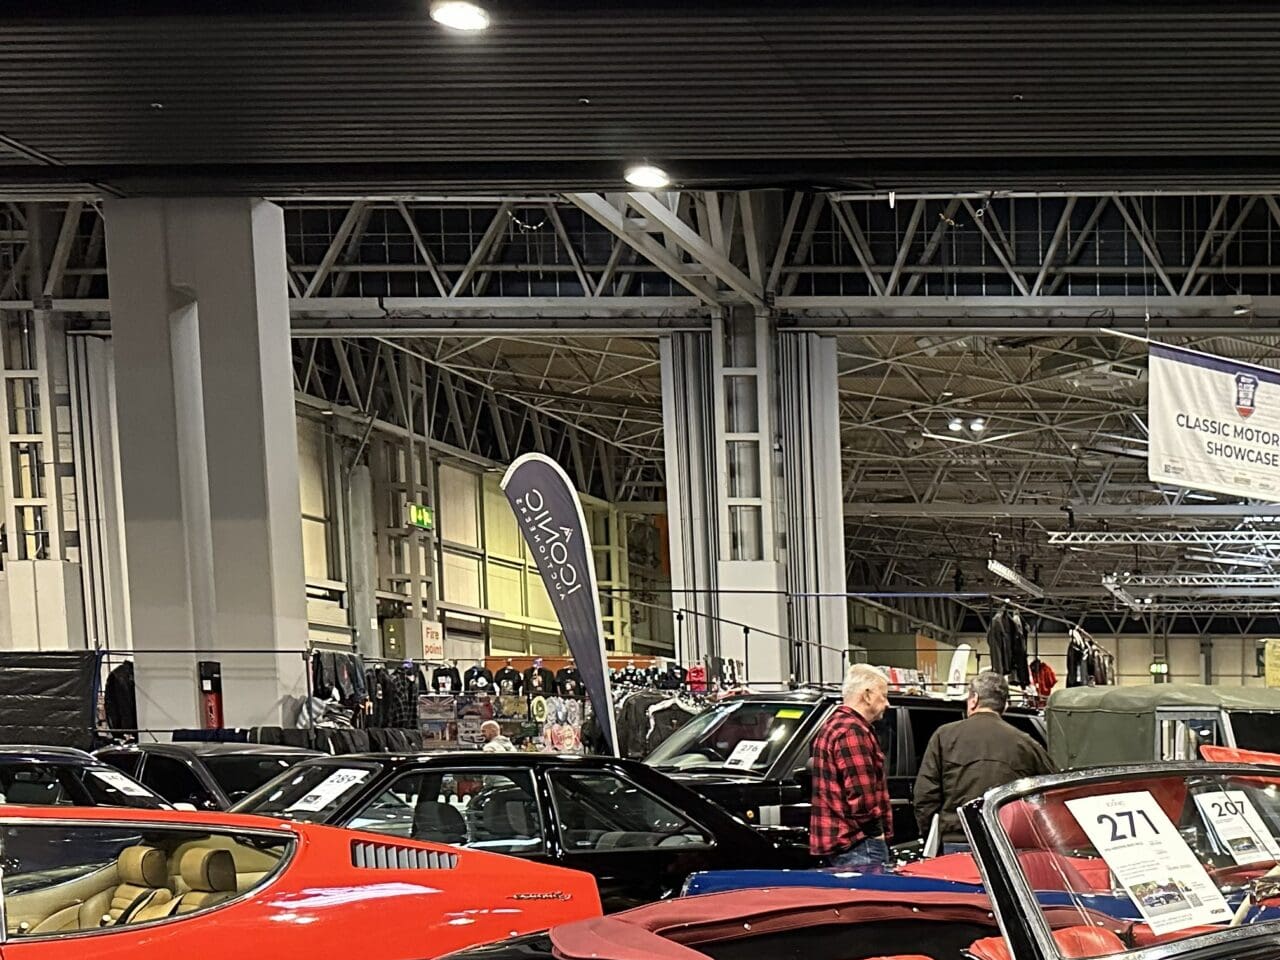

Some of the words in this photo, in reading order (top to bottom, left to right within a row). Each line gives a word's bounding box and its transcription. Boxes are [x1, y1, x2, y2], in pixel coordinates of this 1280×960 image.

[1176, 413, 1230, 437] CLASSIC
[1206, 441, 1280, 468] SHOWCASE
[425, 626, 440, 640] Fire
[425, 643, 443, 656] point
[1211, 800, 1246, 818] 207
[1096, 809, 1161, 842] 271
